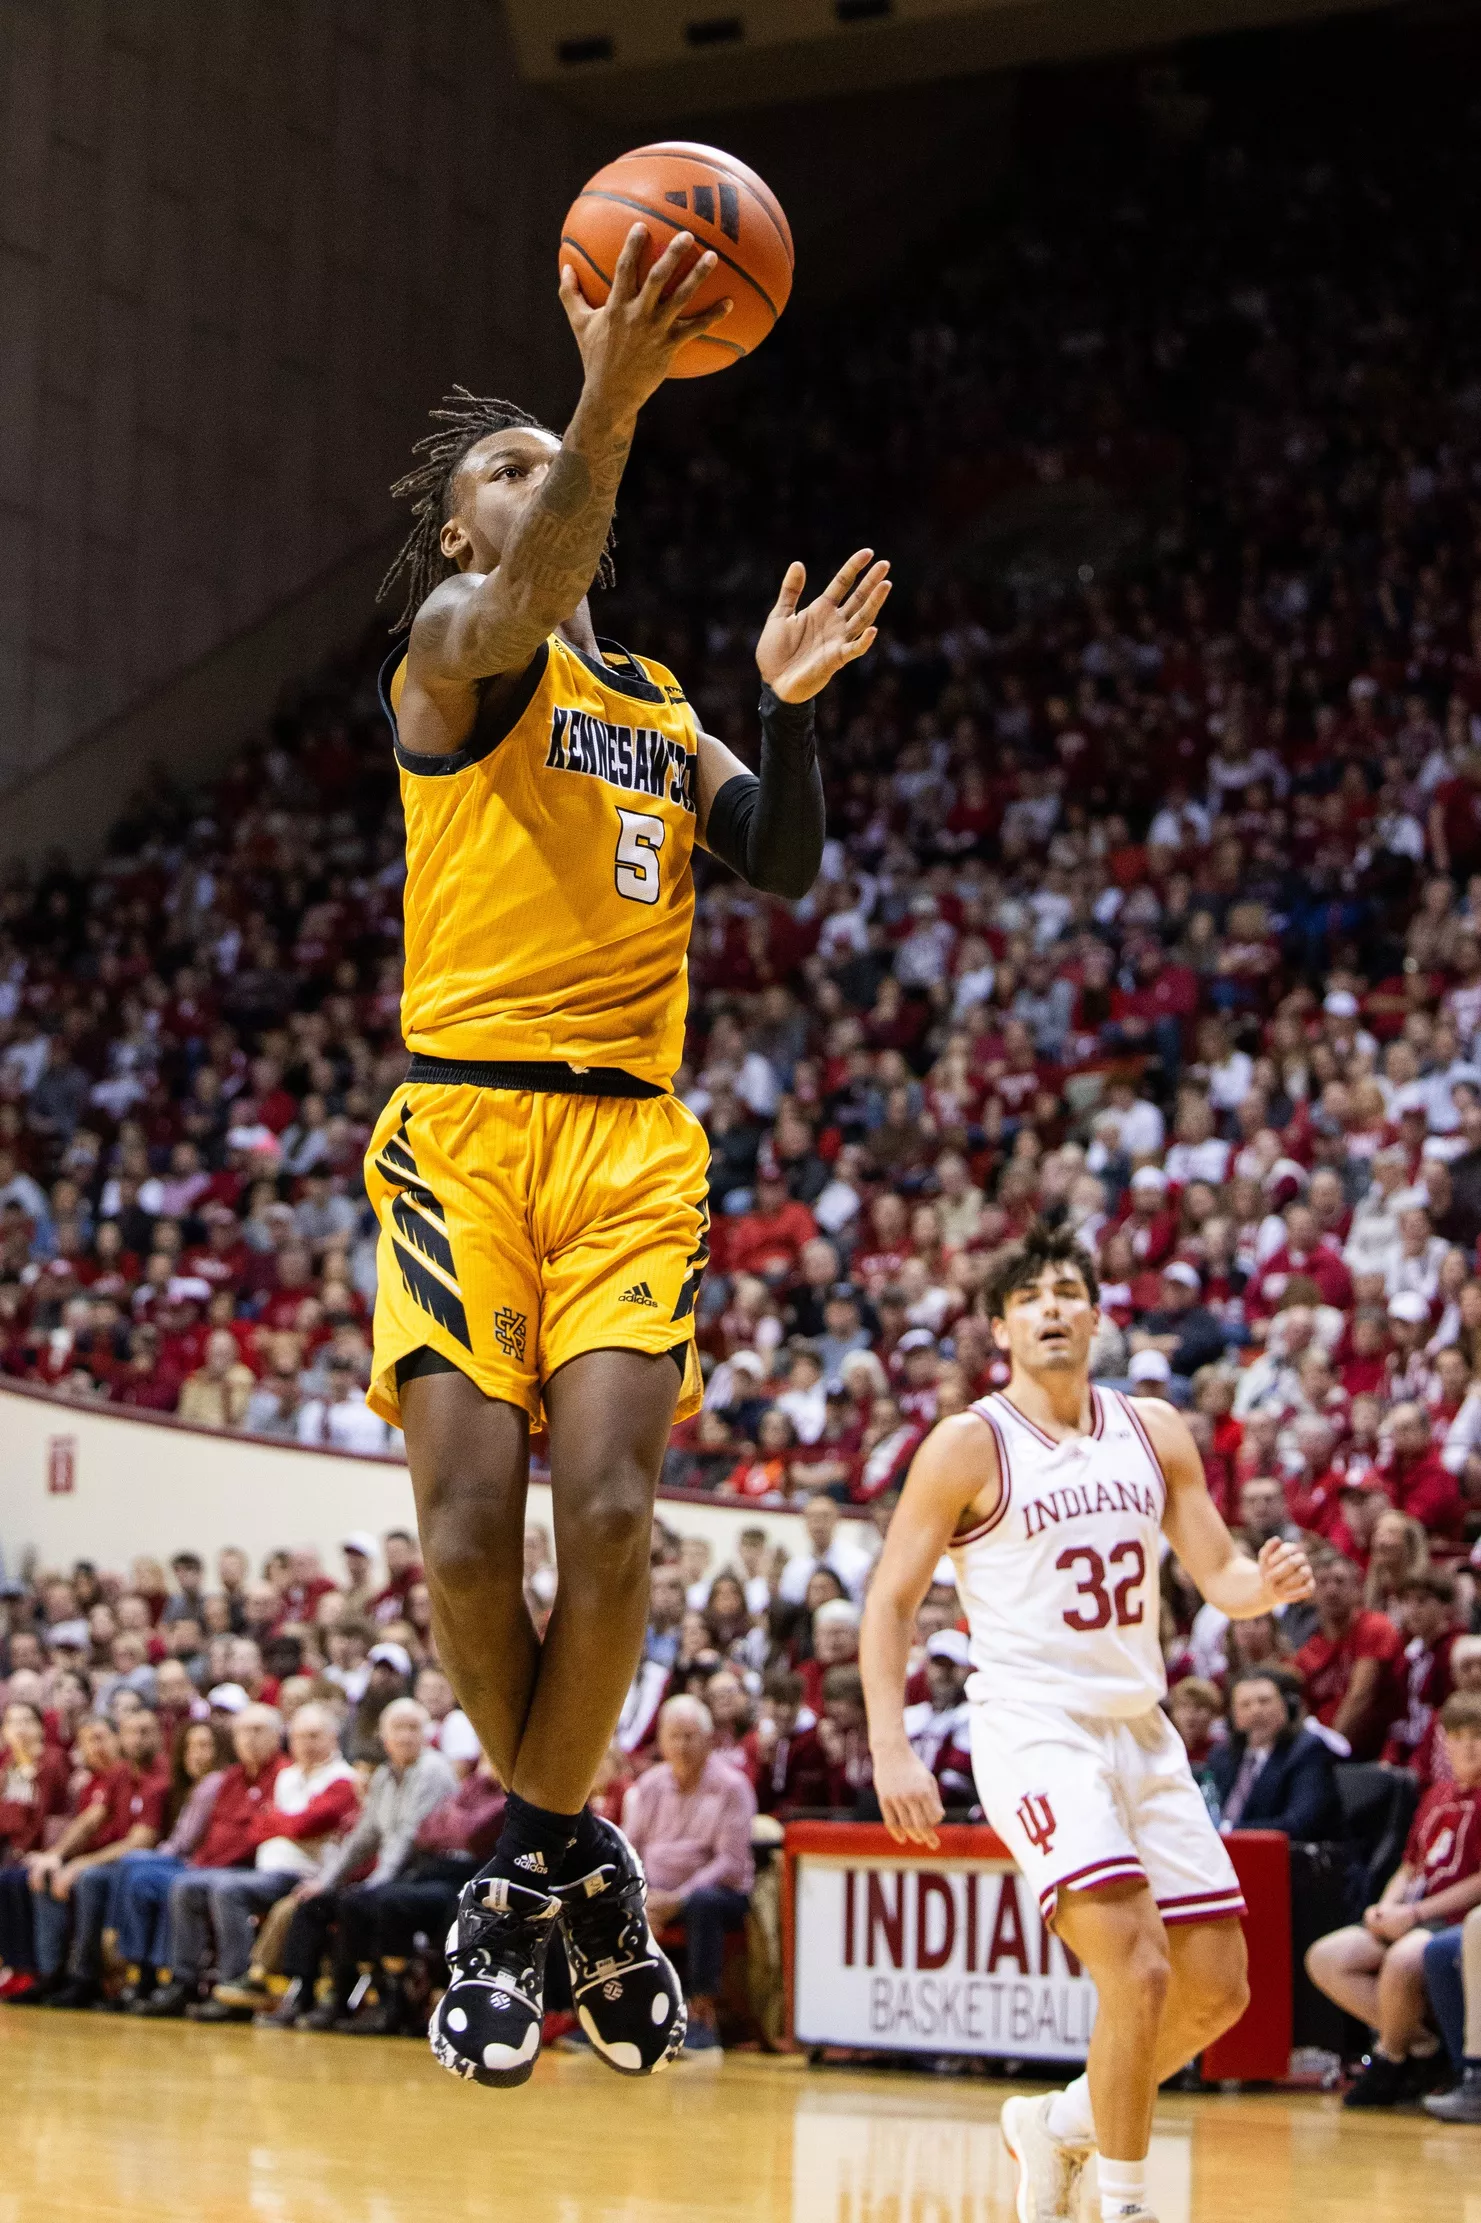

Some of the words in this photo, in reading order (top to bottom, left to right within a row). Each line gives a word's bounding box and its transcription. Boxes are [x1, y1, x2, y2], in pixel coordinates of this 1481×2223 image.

[543, 703, 666, 800] KENNESAW
[614, 805, 665, 905] 5
[618, 1293, 659, 1308] adidas
[1022, 1480, 1158, 1540] INDIANA
[1055, 1540, 1145, 1631] 32
[513, 1857, 549, 1875] adidas
[868, 1976, 1092, 2046] BASKETBALL
